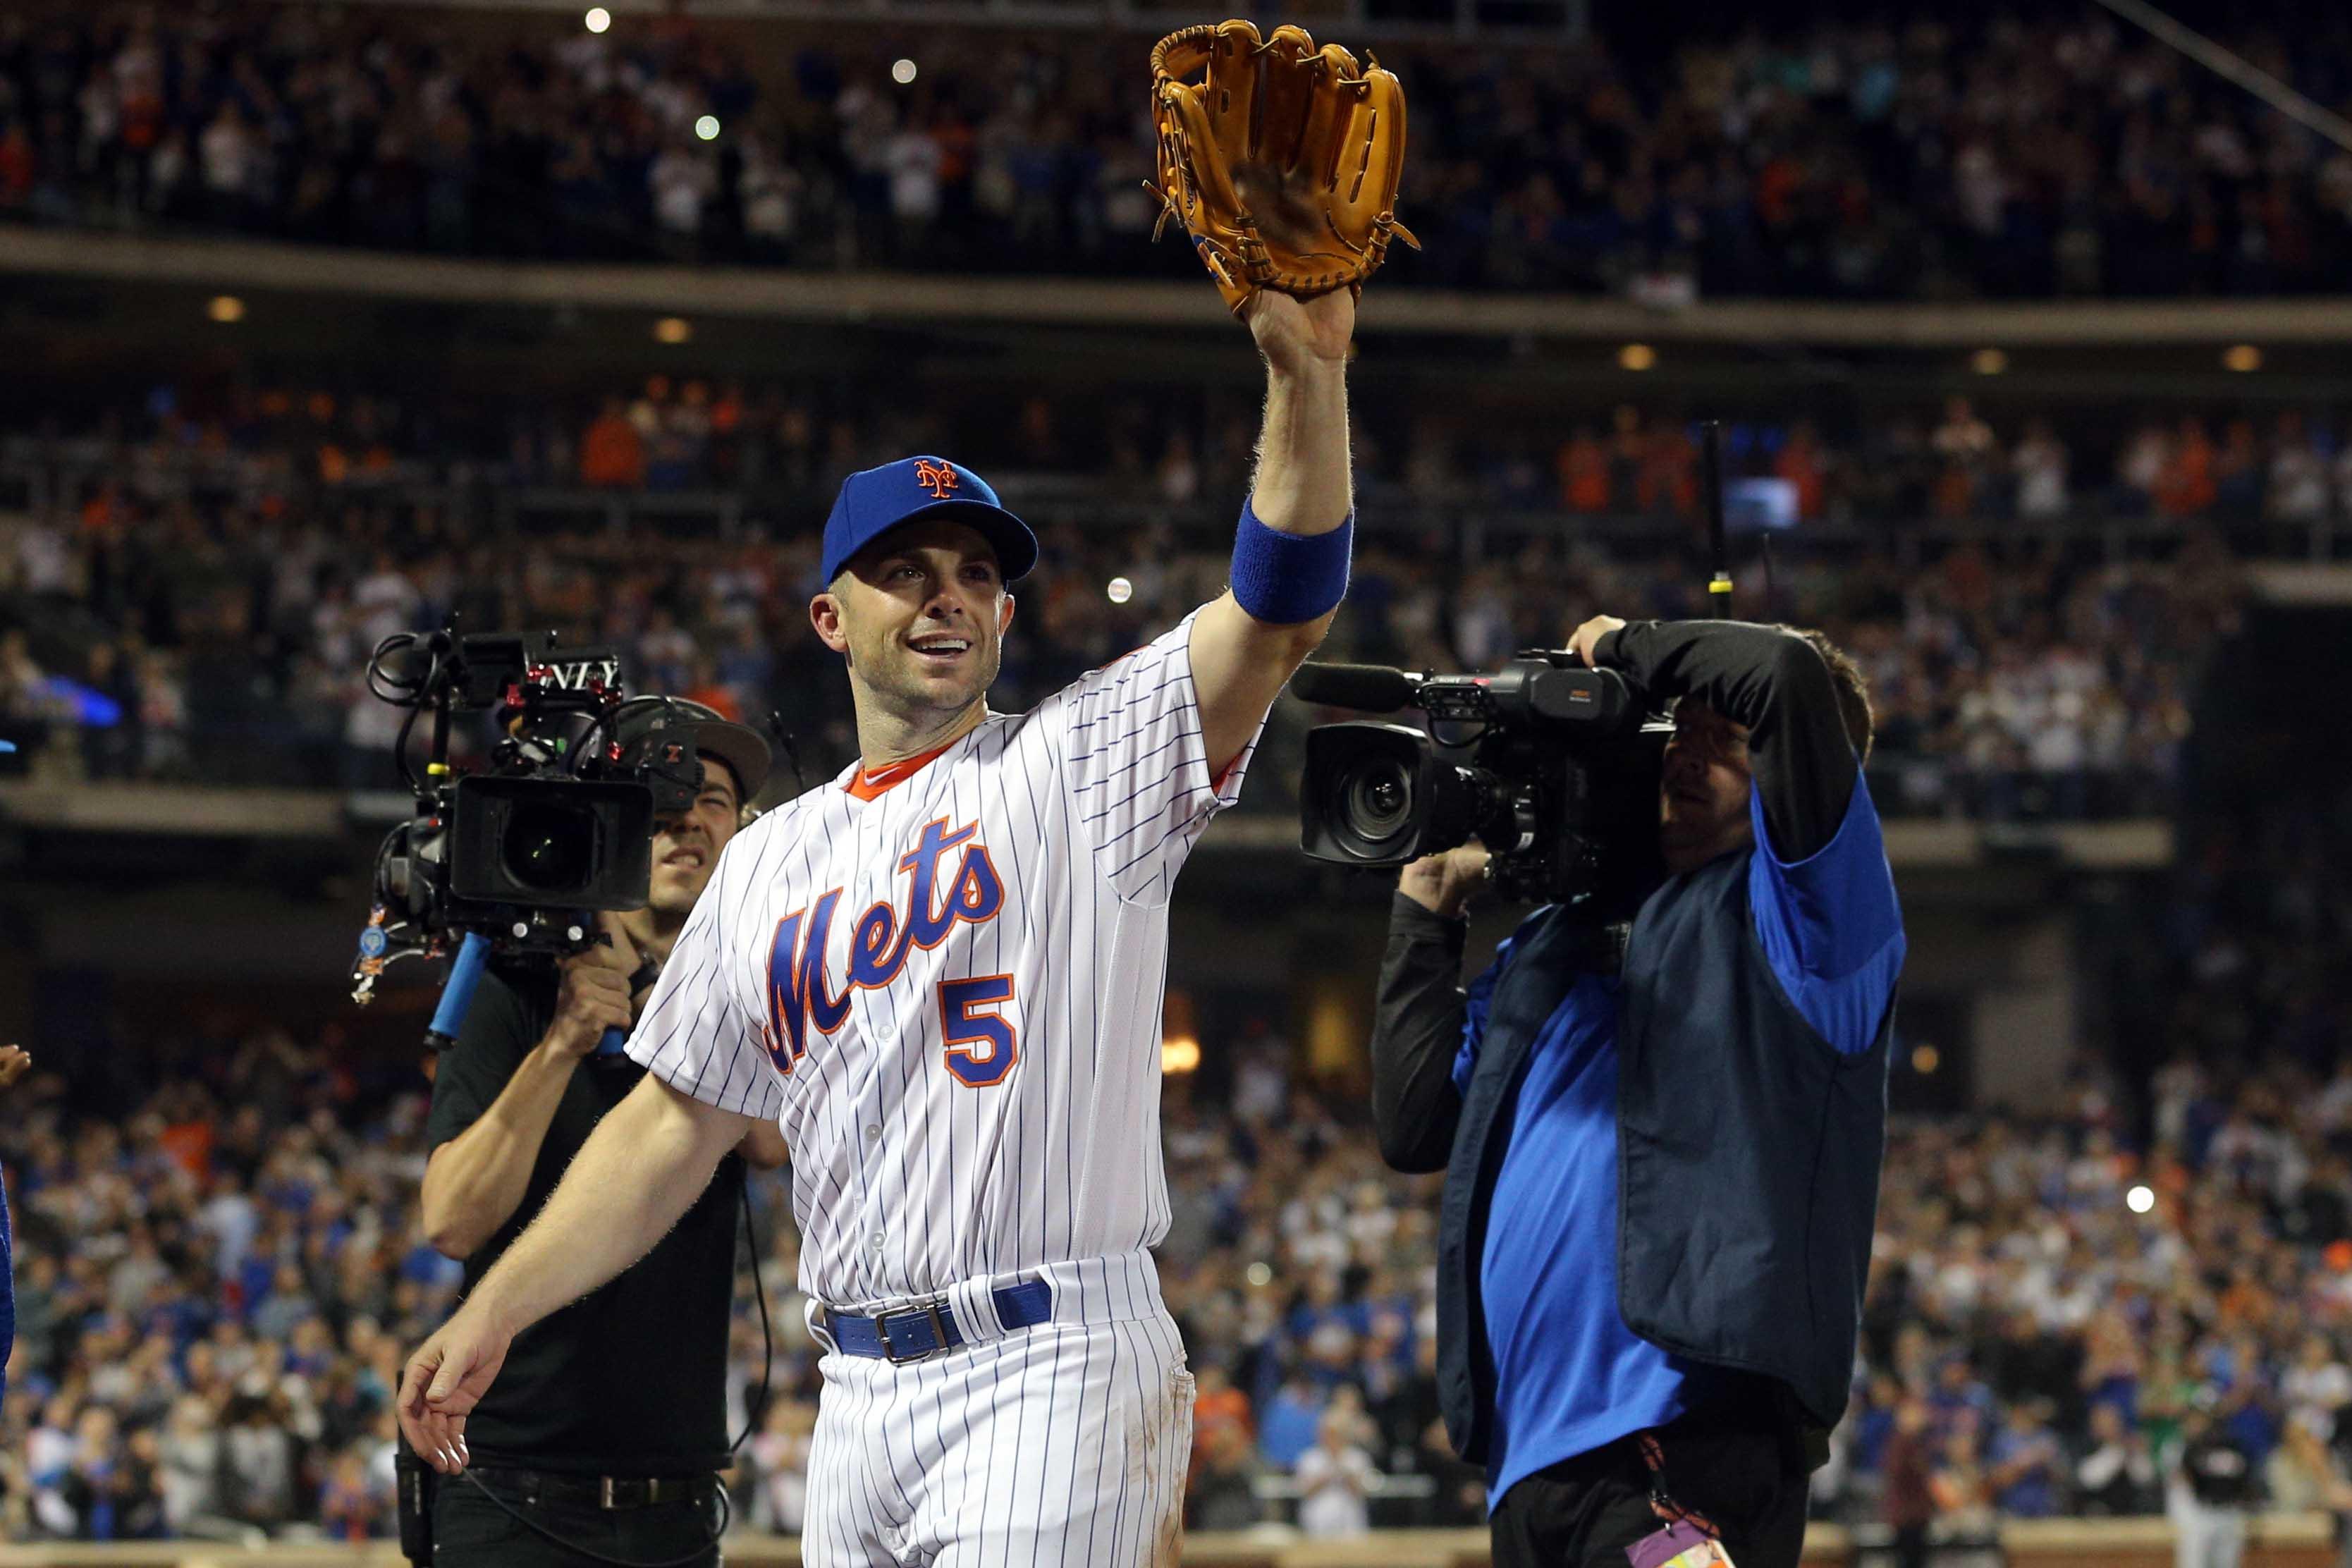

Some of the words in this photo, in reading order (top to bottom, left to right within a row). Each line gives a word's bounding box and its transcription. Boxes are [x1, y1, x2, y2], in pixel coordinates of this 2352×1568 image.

[914, 460, 958, 498] NY
[761, 815, 1005, 1074] Mets
[937, 973, 1017, 1088] 5
